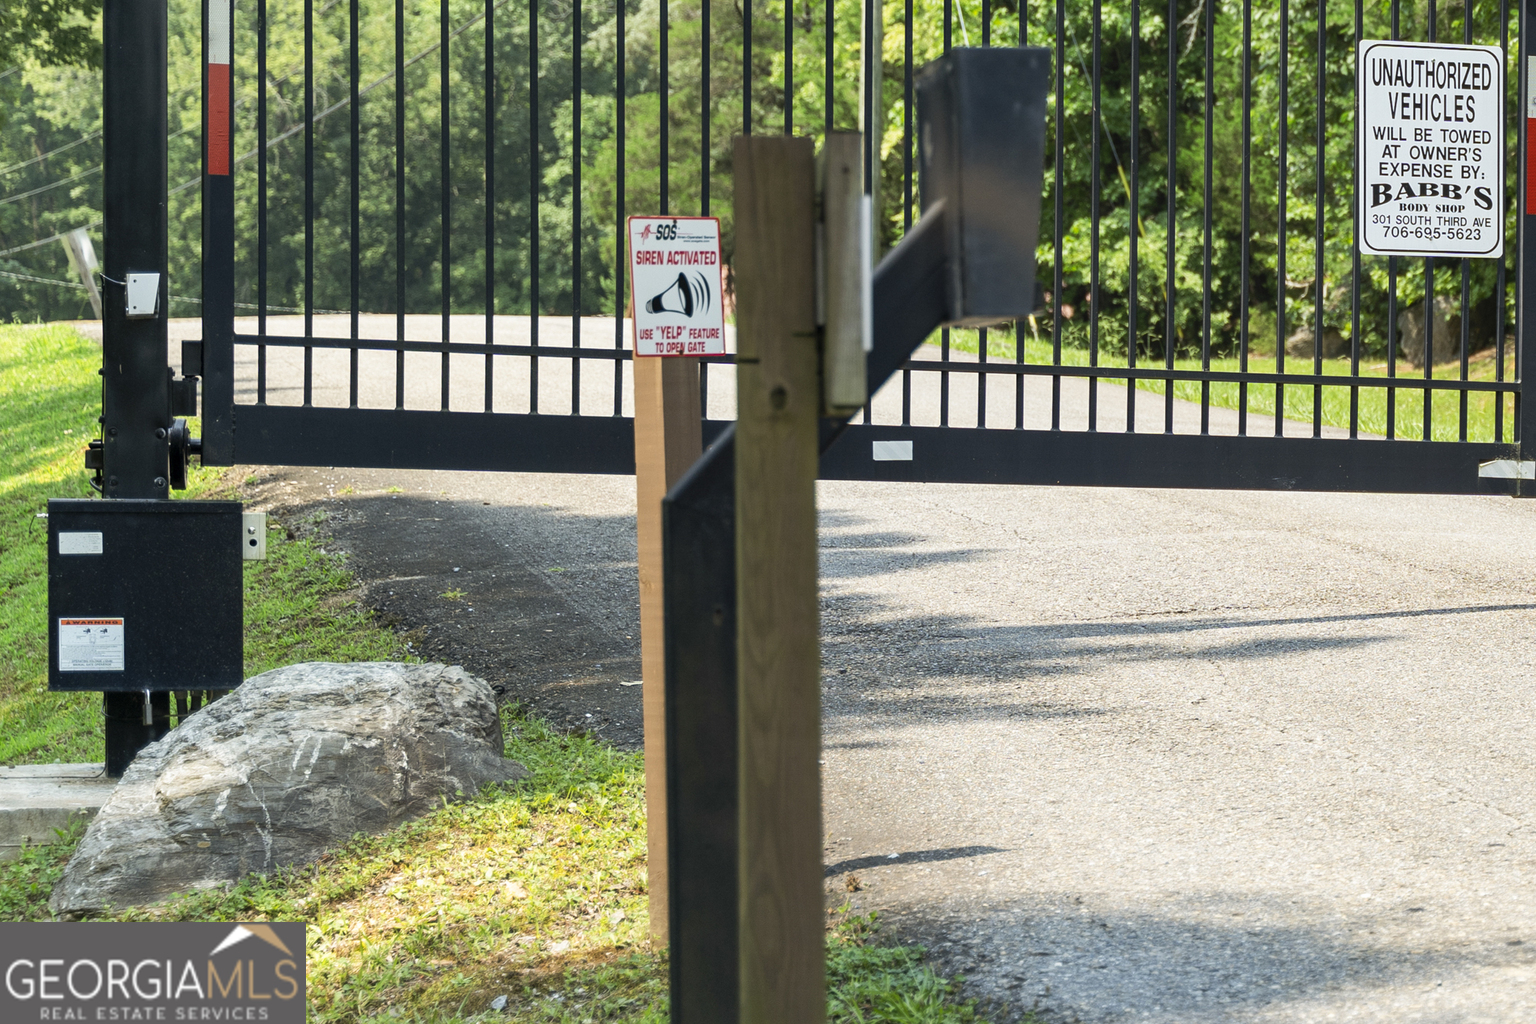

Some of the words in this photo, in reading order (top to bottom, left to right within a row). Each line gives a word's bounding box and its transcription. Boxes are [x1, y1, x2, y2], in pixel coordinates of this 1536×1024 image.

[1372, 58, 1492, 90] UNAUTHORIZED
[1388, 92, 1476, 123] VEHICLES
[1372, 126, 1407, 141] WILL
[1414, 128, 1433, 142] BE
[1440, 128, 1492, 144] TOWED
[1382, 144, 1402, 159] AT
[1409, 146, 1482, 162] OWNER'S
[1379, 162, 1454, 178] EXPENSE
[1461, 165, 1486, 180] BY:
[1370, 182, 1493, 211] BABB'S
[1398, 203, 1430, 212] BODY
[1435, 204, 1466, 213] SHOP
[1372, 214, 1391, 224] 301
[1396, 215, 1432, 226] SOUTH
[1436, 216, 1468, 227] THIRD
[1472, 217, 1492, 228] AVE
[656, 224, 678, 241] SOS
[1382, 226, 1482, 240] 706-695-5623
[636, 250, 664, 265] SIREN
[667, 250, 717, 265] ACTIVATED
[640, 329, 654, 340] USE
[656, 326, 686, 339] "YELP"
[689, 328, 720, 339] FEATURE
[655, 342, 664, 353] TO
[666, 342, 685, 353] OPEN
[688, 342, 706, 352] GATE
